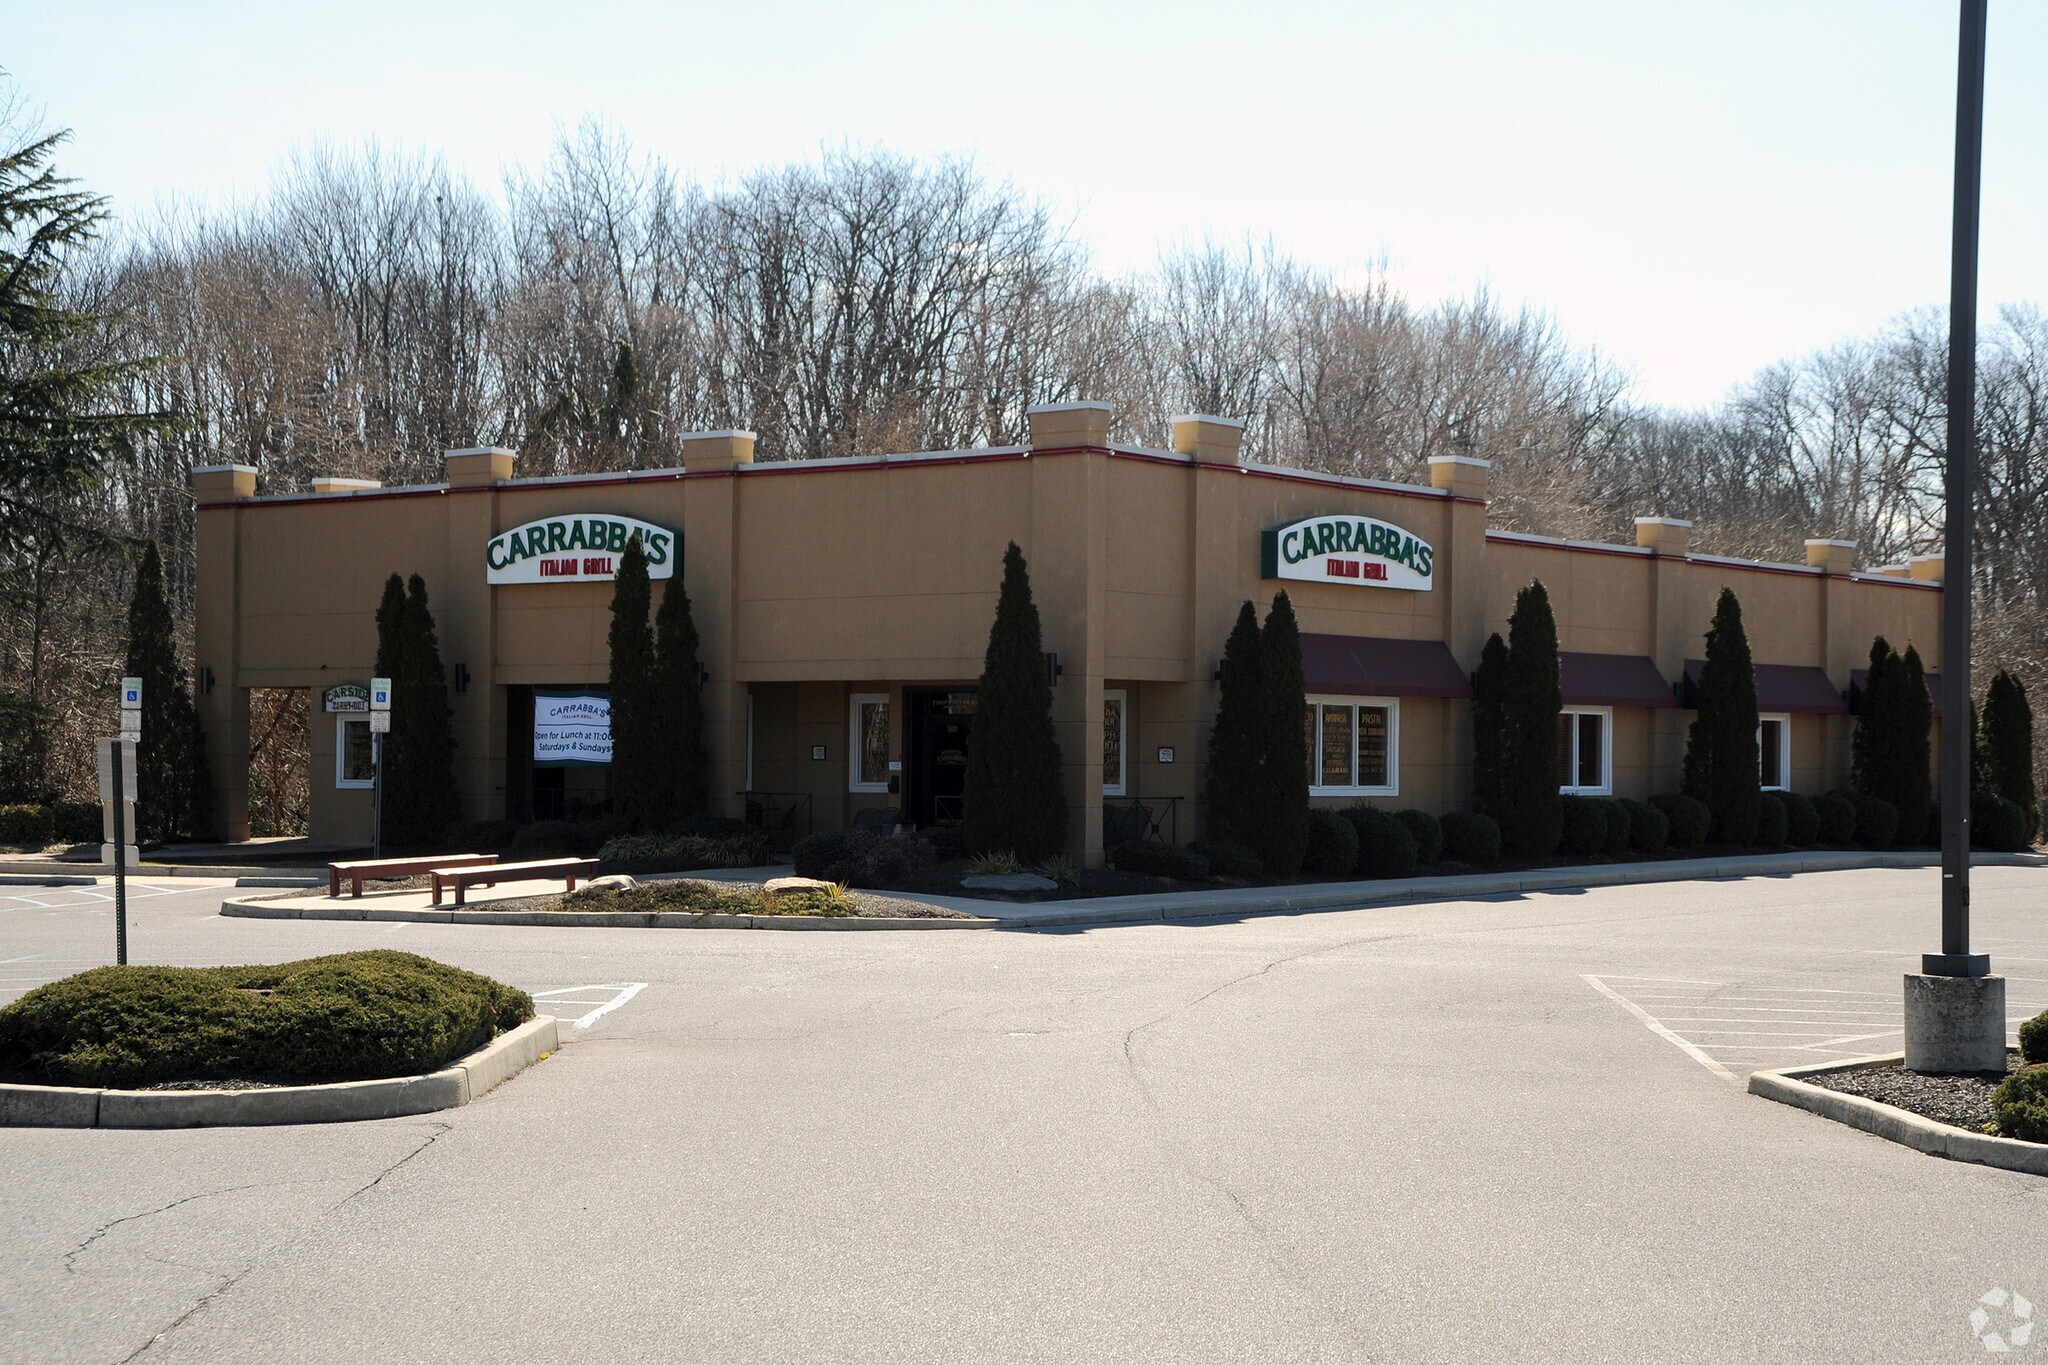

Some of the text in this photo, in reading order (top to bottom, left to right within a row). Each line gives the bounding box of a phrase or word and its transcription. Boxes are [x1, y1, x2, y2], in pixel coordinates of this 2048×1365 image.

[1282, 521, 1434, 577] CARRABBA'S
[540, 558, 613, 576] ITALIAN GRILL
[1327, 558, 1388, 581] ITALIAN GRILL
[549, 704, 606, 718] CARRABBA'S
[549, 731, 559, 740] for
[560, 731, 583, 740] Lunch
[584, 732, 592, 740] at
[539, 742, 611, 754] Saturdays & Sundays
